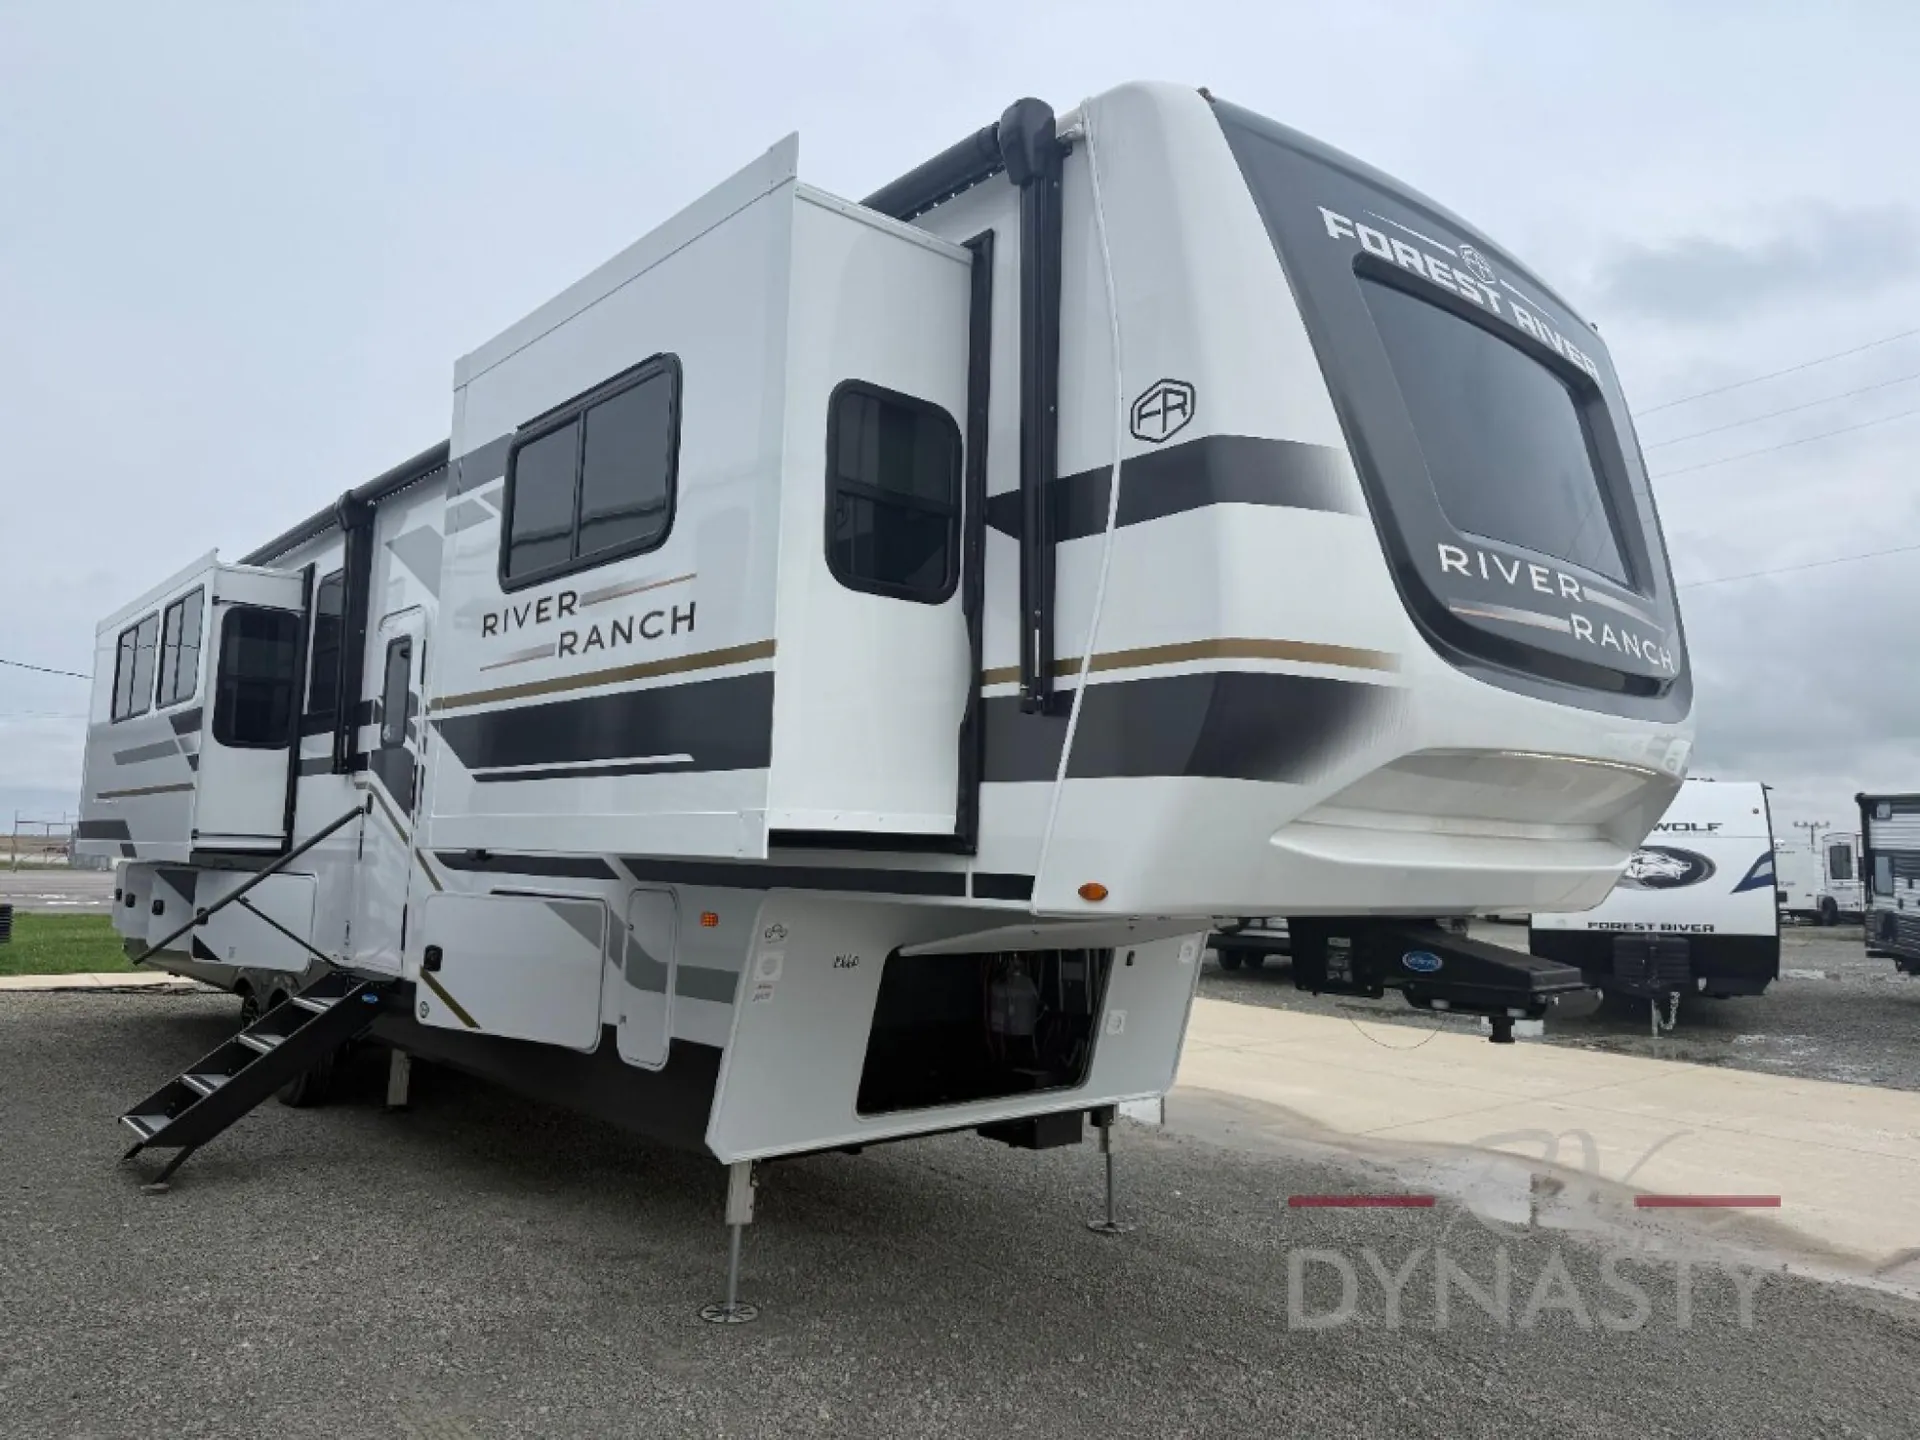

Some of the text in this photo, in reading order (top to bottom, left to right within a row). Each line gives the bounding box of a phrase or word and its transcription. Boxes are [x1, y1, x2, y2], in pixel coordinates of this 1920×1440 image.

[1317, 205, 1603, 385] FOREST RIVER
[1437, 543, 1582, 602] RIVER
[482, 590, 579, 638] RIVER
[558, 601, 697, 658] RANCH
[1570, 612, 1676, 674] RANCH
[1653, 822, 1723, 832] WOLF
[1587, 921, 1715, 933] FOREST RIVER
